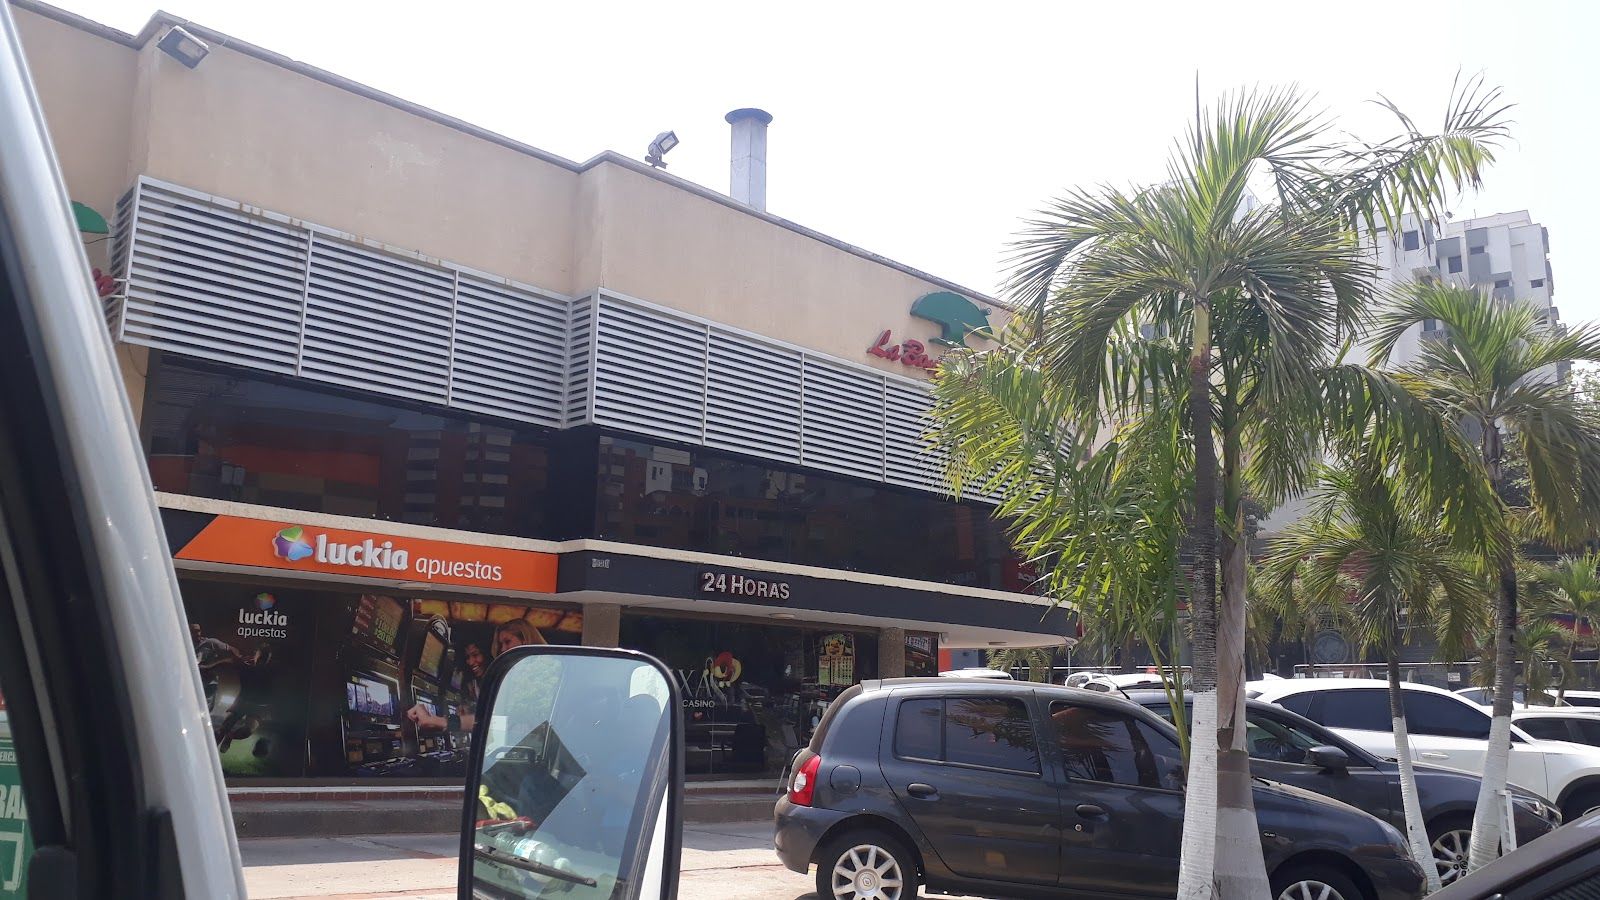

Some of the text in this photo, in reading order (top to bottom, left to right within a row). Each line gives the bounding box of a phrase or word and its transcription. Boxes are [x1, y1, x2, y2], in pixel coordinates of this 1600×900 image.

[866, 330, 900, 361] La
[315, 534, 502, 581] luckia apuestas
[704, 572, 790, 600] 24 HORAS
[238, 608, 288, 626] luckia
[237, 627, 287, 638] apuestas
[682, 699, 715, 708] CASINO
